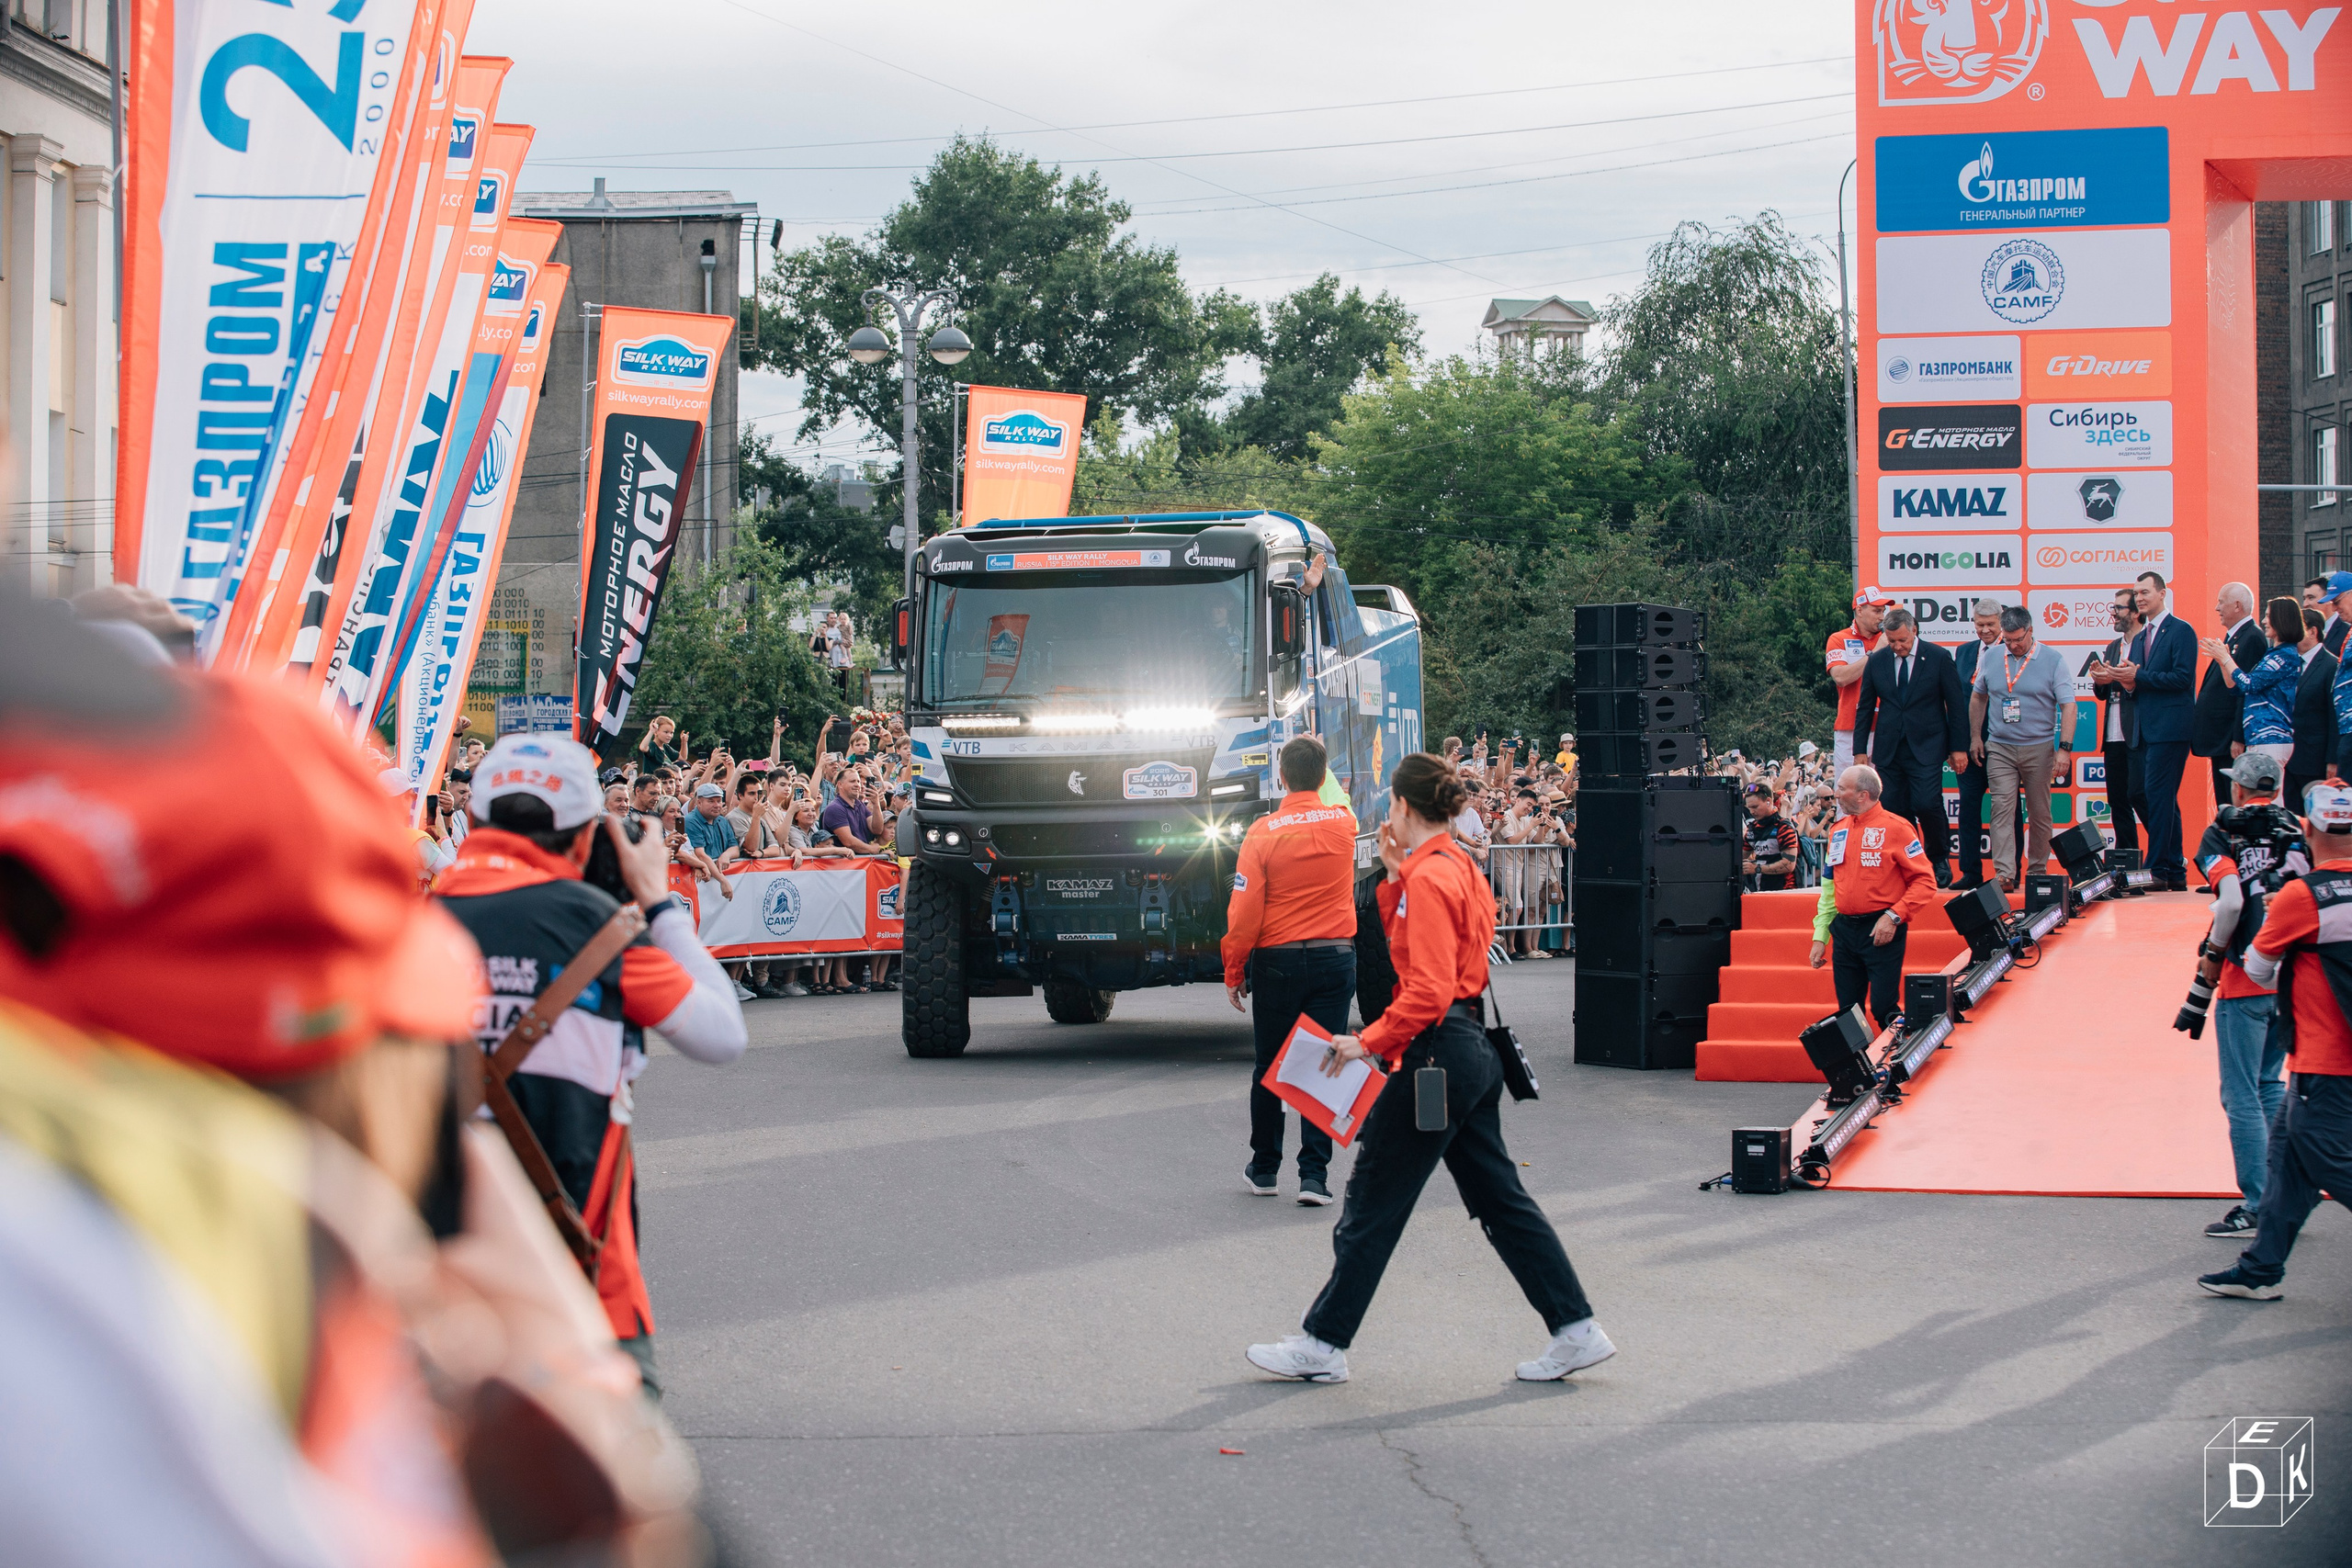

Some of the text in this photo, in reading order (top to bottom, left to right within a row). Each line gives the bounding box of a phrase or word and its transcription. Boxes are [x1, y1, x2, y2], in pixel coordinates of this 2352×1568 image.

[2071, 7, 2343, 98] WAY
[1996, 177, 2086, 202] ГАЗПРОМ
[1960, 208, 2086, 221] ГЕНЕРАЛЬНЫЙ ПАРТНЕР
[1994, 296, 2052, 309] CAMF
[622, 351, 707, 368] SILK WAY
[641, 365, 685, 374] RALLY
[1919, 361, 2013, 376] ГАЗПРОМБАНК
[607, 389, 708, 410] silkwayrally.com
[2049, 408, 2137, 430] Сибирь
[988, 424, 1060, 439] SILK WAY
[2085, 429, 2151, 446] здесь
[975, 459, 1065, 475] silkwayrally.com
[1893, 487, 2007, 518] KAMAZ
[600, 432, 638, 660] МОТОРНОЕ МАСЛО
[1200, 556, 1236, 568] ГАЗПРОМ
[1889, 551, 2011, 570] MONGOLIA
[2069, 548, 2165, 564] СОГЛАСИЕ
[941, 560, 973, 572] ГАЗПРОМ
[953, 741, 980, 754] VTB
[1132, 773, 1189, 784] SILK WAY
[1860, 852, 1882, 860] SILK
[1047, 879, 1114, 890] KAMAZ
[1061, 890, 1101, 898] master
[767, 917, 795, 925] CAMF
[876, 931, 903, 940] #silkwayr
